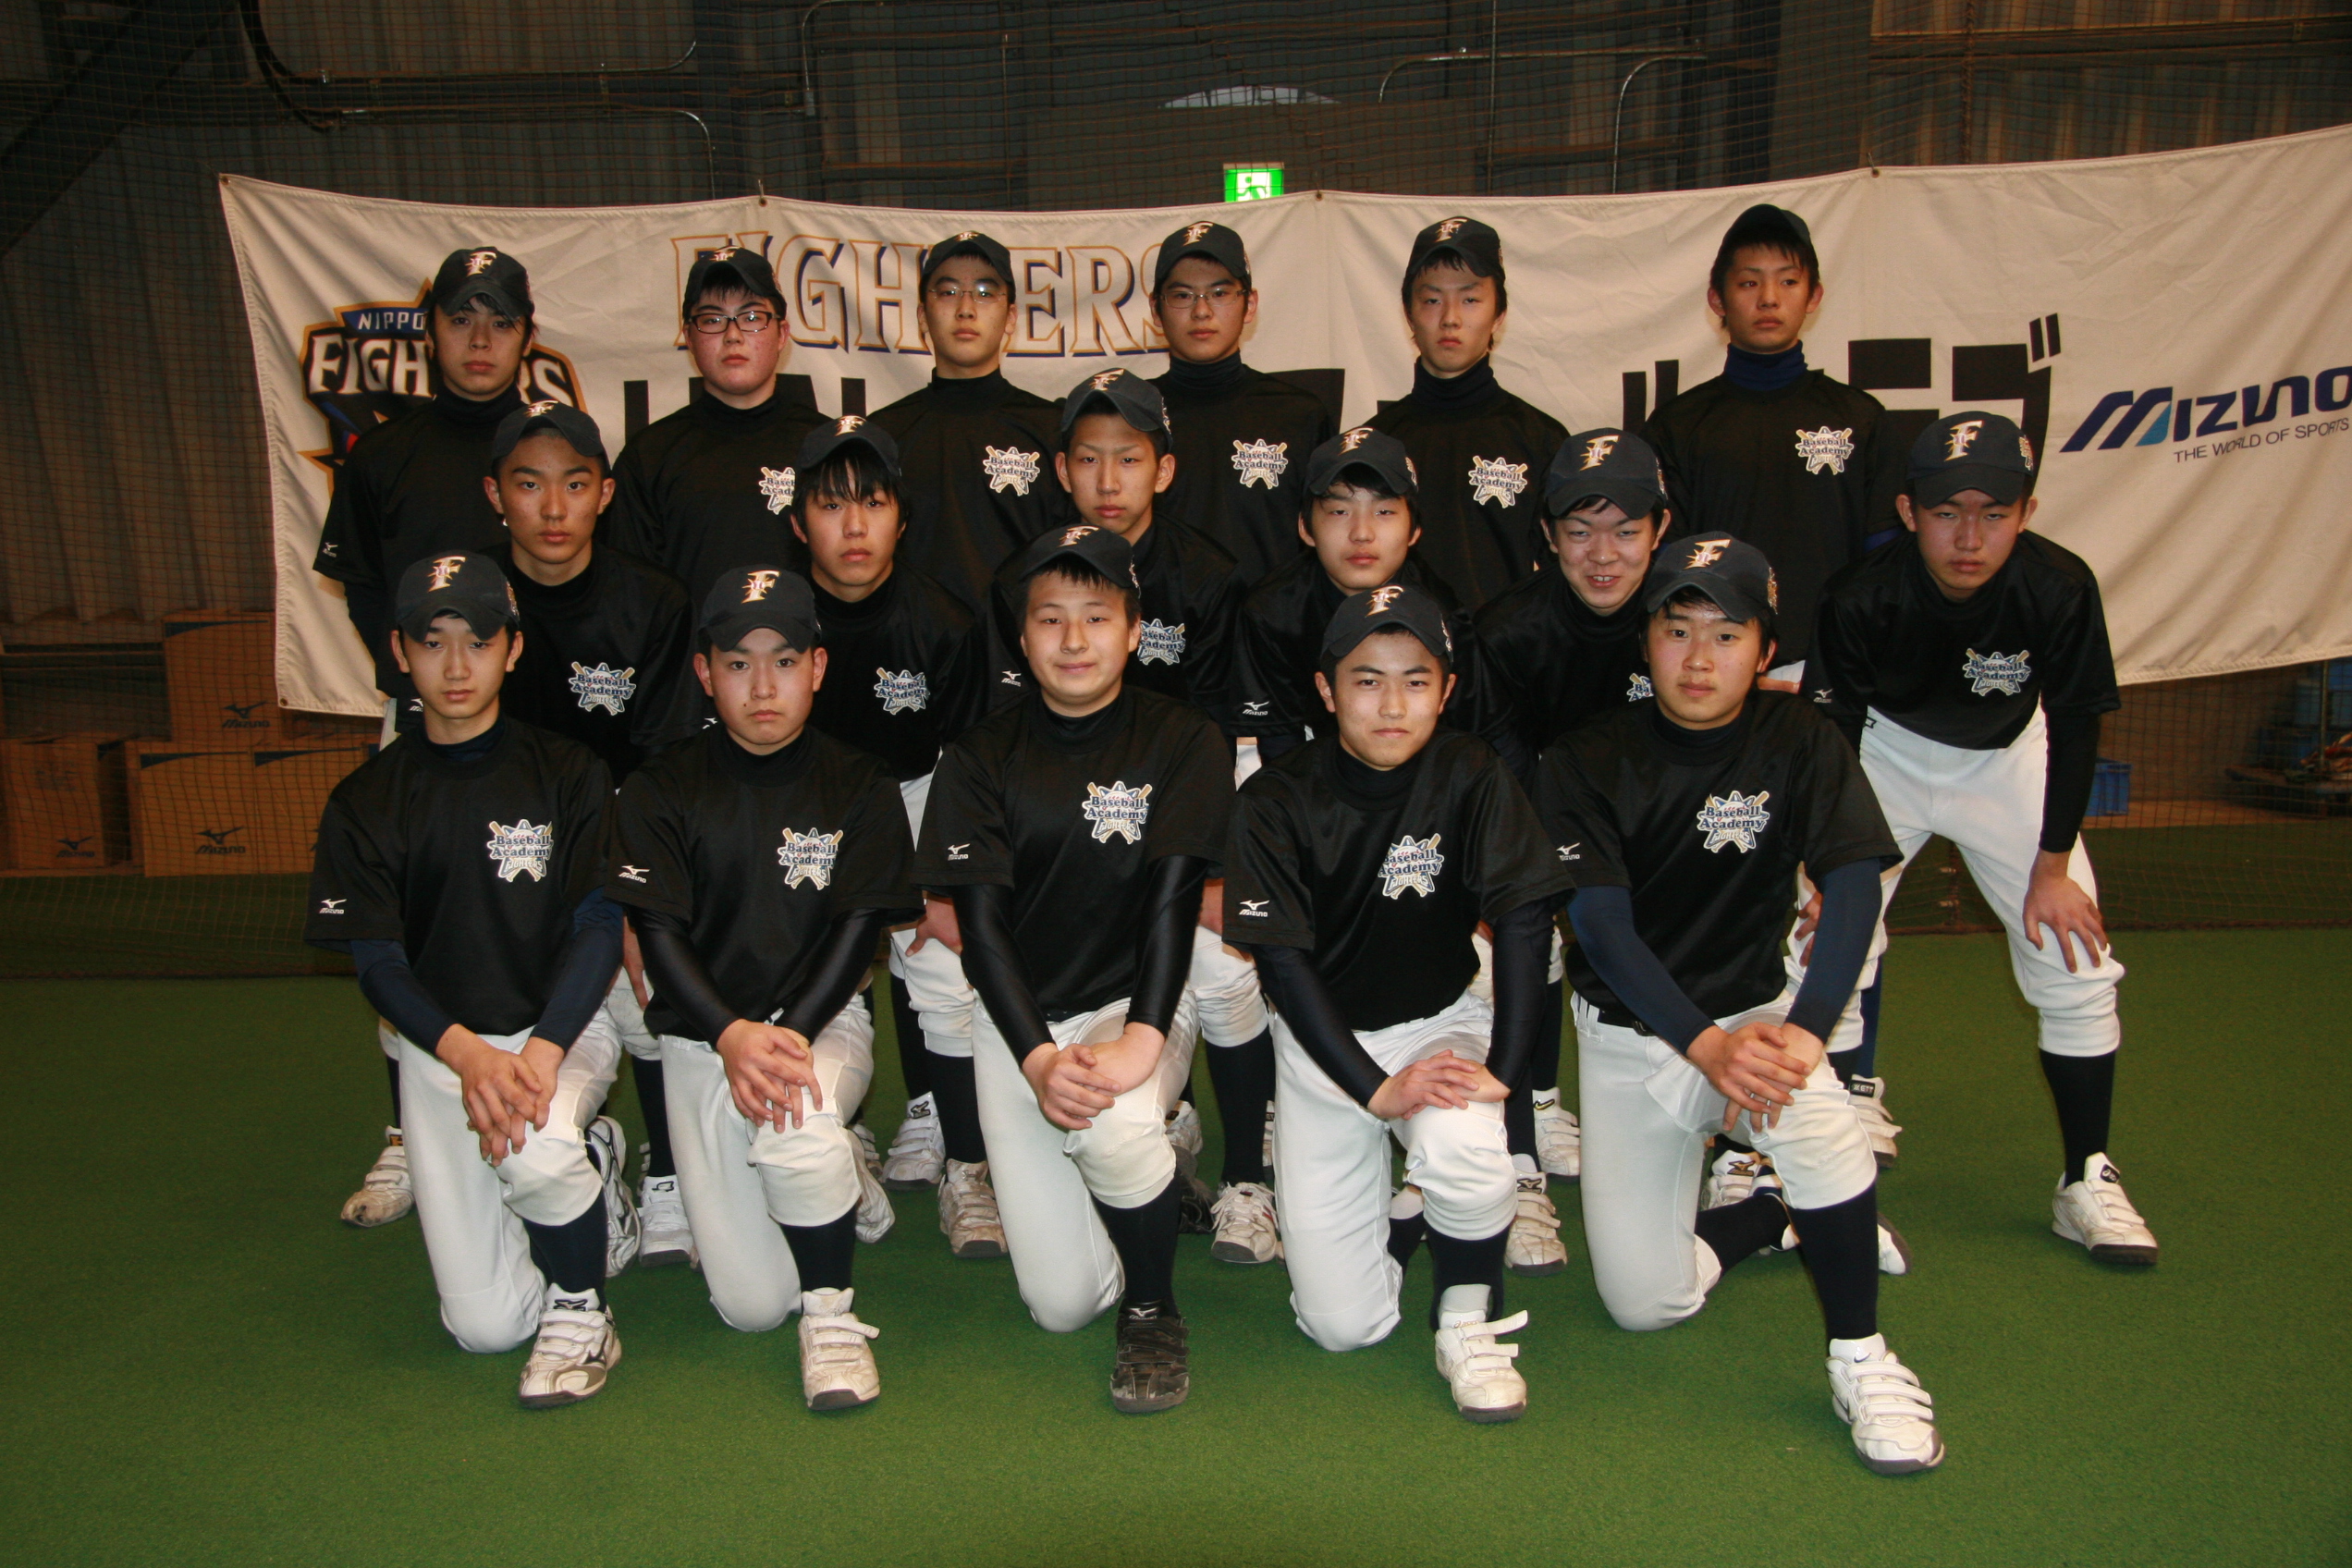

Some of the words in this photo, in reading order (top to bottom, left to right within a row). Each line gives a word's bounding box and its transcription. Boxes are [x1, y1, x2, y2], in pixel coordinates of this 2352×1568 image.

[357, 311, 424, 332] NIPPO
[2174, 445, 2208, 463] THE
[2212, 434, 2261, 457] WORLD
[2265, 428, 2290, 445] OF
[2294, 417, 2350, 439] SPORTS
[1239, 451, 1282, 461] Baseball
[1800, 447, 1848, 457] Academy
[990, 457, 1034, 469] Baseball
[1235, 460, 1285, 472] Academy
[986, 465, 1036, 479] Academy
[1476, 467, 1521, 480] Baseball
[1472, 476, 1525, 490] Academy
[1141, 631, 1180, 641] aseball
[1139, 640, 1185, 651] cademy
[1971, 659, 2023, 671] Baseball
[577, 674, 629, 686] Baseball
[1968, 668, 2026, 680] Academy
[573, 684, 631, 697] Academy
[878, 688, 925, 699] Academ
[1091, 796, 1144, 808] Baseball
[1088, 807, 1147, 821] Academy
[1706, 805, 1761, 817] Baseball
[1701, 817, 1765, 830] Academy
[496, 835, 550, 845] Baseball
[787, 842, 837, 853] Baseball
[782, 854, 835, 866] Academ
